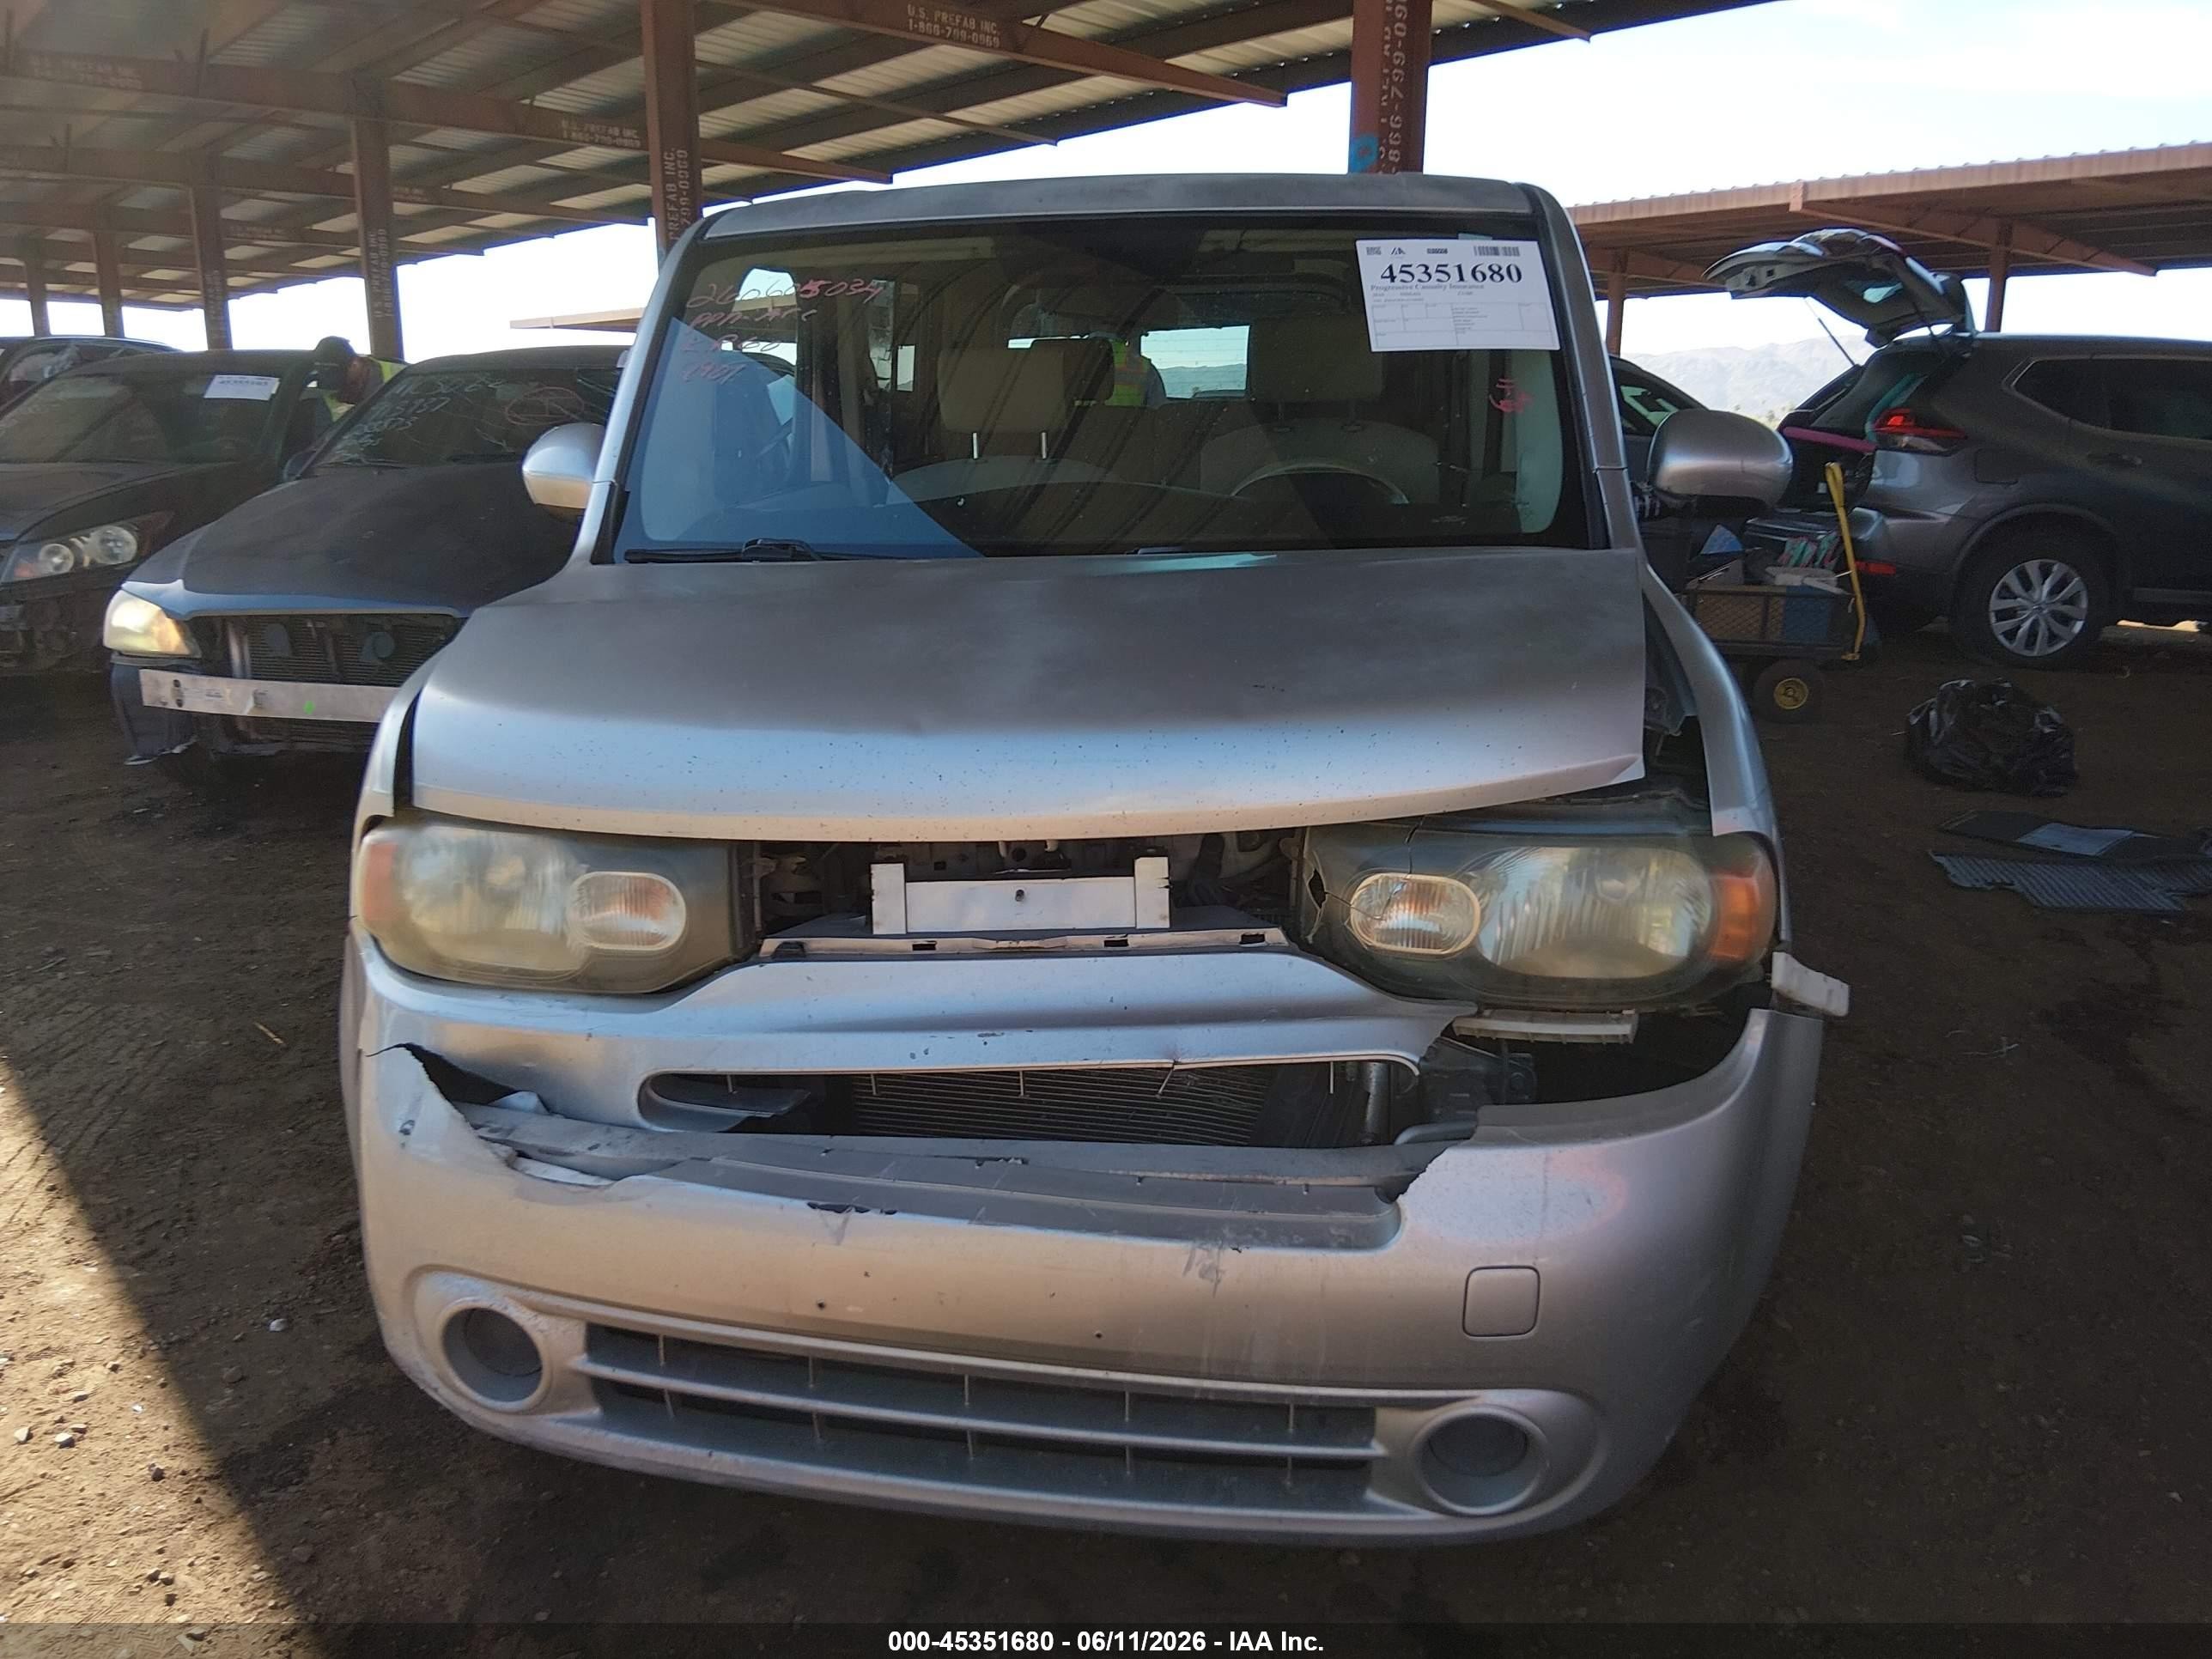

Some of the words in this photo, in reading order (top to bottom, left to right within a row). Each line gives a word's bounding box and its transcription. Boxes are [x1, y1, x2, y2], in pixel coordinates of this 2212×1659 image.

[907, 3, 929, 21] U.S.
[933, 10, 976, 30] PREFAB
[664, 147, 678, 175] INC.
[1380, 263, 1523, 284] 45351680
